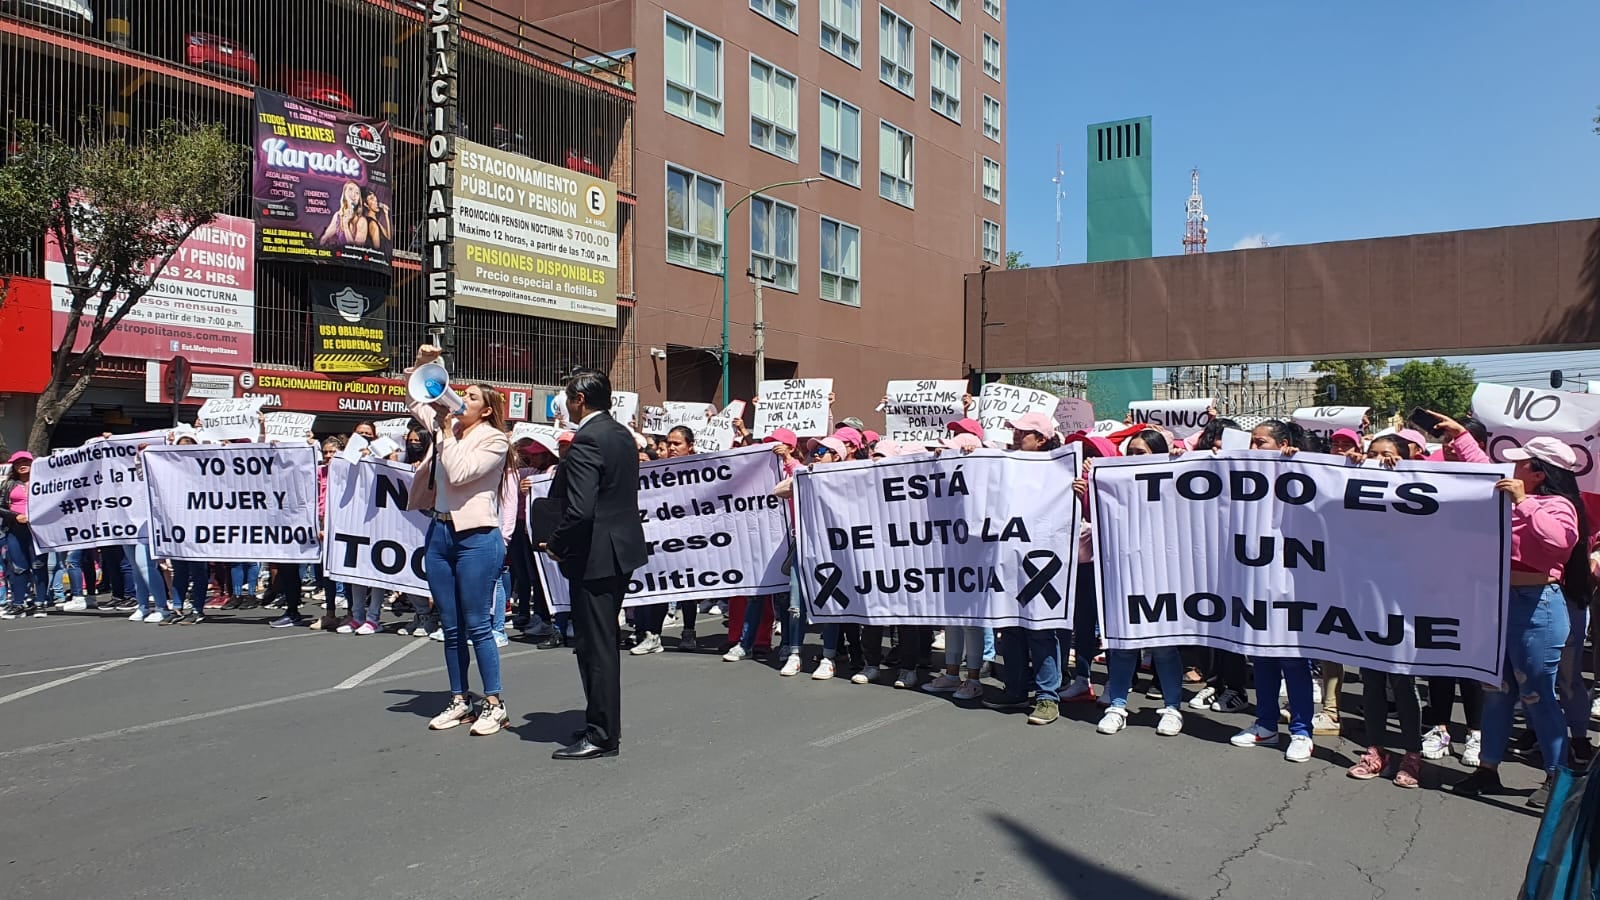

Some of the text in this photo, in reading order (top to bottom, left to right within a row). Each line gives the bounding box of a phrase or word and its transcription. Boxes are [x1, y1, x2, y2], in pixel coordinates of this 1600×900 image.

[259, 112, 286, 126] ¡TODOS
[273, 123, 336, 143] LOS VIERNES!
[261, 137, 360, 176] Karaoke
[429, 0, 449, 350] STACIONAMIENT
[460, 149, 578, 196] ESTACIONAMIENTO
[460, 173, 577, 219] PÚBLICO Y PENSIÓN
[591, 190, 600, 211] E
[459, 206, 500, 225] PROMOCIÓN
[531, 221, 563, 238] NOCTURNA
[585, 216, 593, 225] 24
[262, 228, 277, 236] CALLE
[459, 222, 610, 263] Máximo 12 horas, a partir de las 7:00 p.m.
[179, 248, 188, 261] Y
[191, 249, 245, 271] PENSIÓN
[466, 245, 605, 285] PENSIONES DISPONIBLES
[184, 267, 202, 280] 24
[205, 270, 240, 286] HRS.
[475, 267, 598, 298] Precio especial a flotillas
[186, 285, 238, 302] NOCTURNA
[462, 283, 557, 306] www.metropolitanos.com.mx
[140, 297, 238, 315] esos mensuales
[155, 310, 179, 324] partir
[181, 313, 191, 322] de
[193, 314, 206, 324] las
[208, 316, 225, 327] 7:00
[227, 319, 244, 329] p.m.
[319, 325, 337, 336] USO
[181, 343, 238, 355] Est.Metropolitanos
[323, 339, 335, 349] DE
[243, 375, 251, 385] E
[259, 375, 343, 392] ESTACIONAMIENTO
[344, 380, 380, 395] PÚBLICO
[381, 385, 388, 394] Y
[388, 385, 407, 397] PENS
[784, 379, 806, 390] SON
[916, 380, 937, 391] SON
[766, 389, 823, 401] VICTIMAS
[896, 391, 957, 403] VICTIMAS
[984, 385, 1048, 406] ESTA DE
[1504, 387, 1561, 422] NO
[210, 403, 251, 414] LUTO LA
[338, 398, 409, 413] SALIDA Y ENTRA
[758, 401, 822, 411] INVENTADAS
[887, 404, 954, 415] INVENTADAS
[1011, 401, 1031, 414] LA
[1314, 407, 1345, 418] NO
[204, 413, 249, 429] JUSTICIA
[768, 411, 798, 422] POR LA
[909, 416, 944, 428] POR LA
[266, 425, 309, 438] DILATES
[48, 444, 137, 469] Cuauhtémoc
[196, 456, 275, 476] YO SOY
[31, 475, 91, 496] Gutiérrez
[110, 468, 124, 483] la
[883, 464, 969, 502] ESTÁ
[187, 491, 286, 510] MUJER Y
[376, 474, 409, 511] N
[1135, 470, 1440, 516] TODO ES
[656, 502, 685, 521] de
[692, 498, 715, 516] la
[718, 492, 779, 509] Torre
[155, 525, 316, 547] ¡LO DEFIENDO!
[649, 531, 732, 555] reso
[827, 517, 1031, 550] DE LUTO LA
[1234, 533, 1326, 572] UN
[626, 567, 744, 594] olítico
[854, 566, 1004, 595] JUSTICIA
[1128, 592, 1461, 651] MONTAJE
